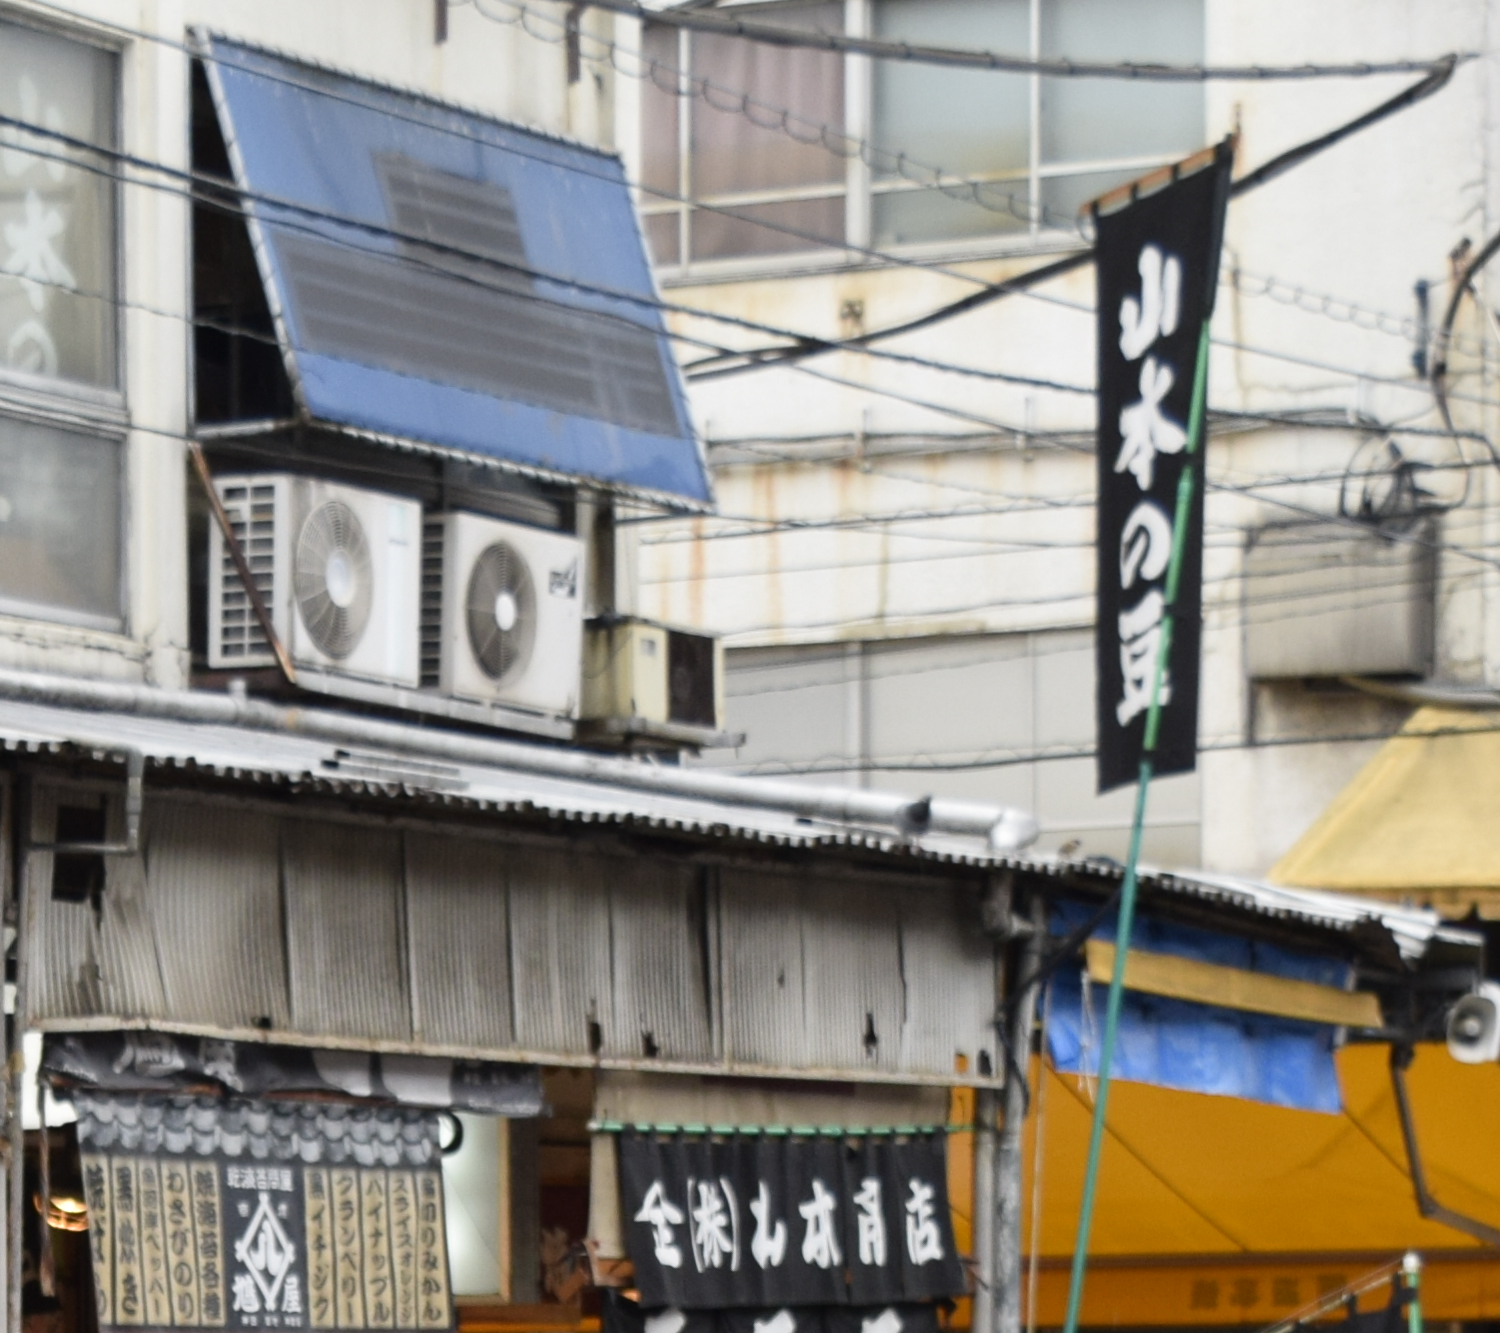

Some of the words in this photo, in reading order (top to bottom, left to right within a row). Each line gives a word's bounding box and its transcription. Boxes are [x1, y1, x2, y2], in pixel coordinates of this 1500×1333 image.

[1114, 244, 1188, 727] 山本の豆
[335, 1175, 358, 1322] クランベリー
